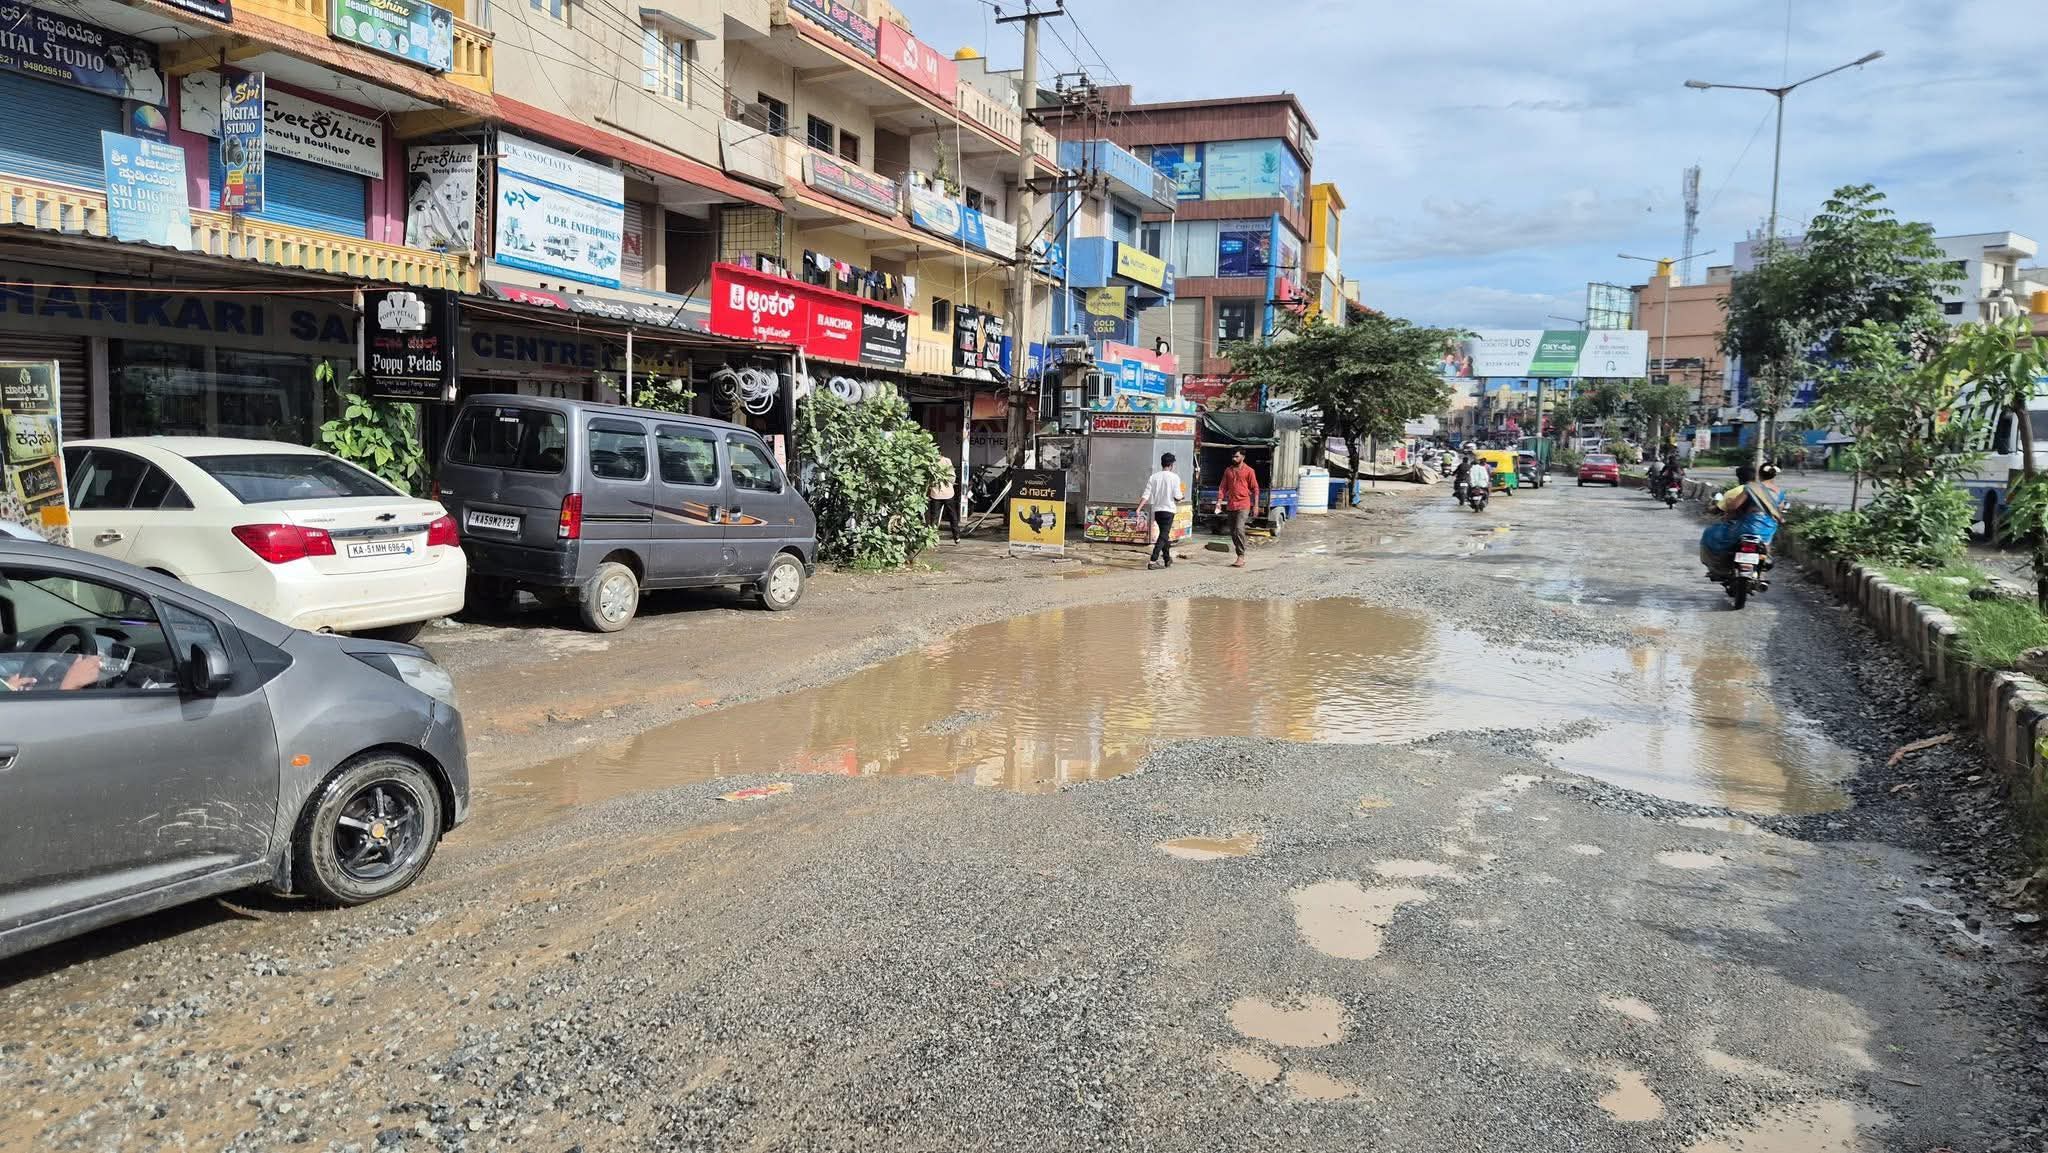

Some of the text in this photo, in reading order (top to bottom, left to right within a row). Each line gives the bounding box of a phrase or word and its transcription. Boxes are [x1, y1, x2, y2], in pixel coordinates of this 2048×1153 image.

[43, 42, 104, 72] STUDIO
[233, 83, 260, 104] Sri
[222, 106, 261, 121] DIGITAL
[226, 122, 256, 135] STUDIO
[303, 136, 352, 156] Boutique
[522, 151, 573, 172] ASSOCIATES
[111, 183, 133, 198] SRI
[112, 196, 161, 215] STUDIO
[545, 213, 569, 229] A.P.R.
[571, 220, 622, 241] ENTERPRISES
[823, 316, 854, 331] ANCHOR
[1093, 319, 1115, 327] GOLD
[471, 330, 597, 369] CENTRE
[1509, 337, 1532, 348] UDS
[372, 353, 442, 374] Poppy Petals
[1094, 418, 1129, 430] BOMBAY
[988, 437, 1005, 446] THE
